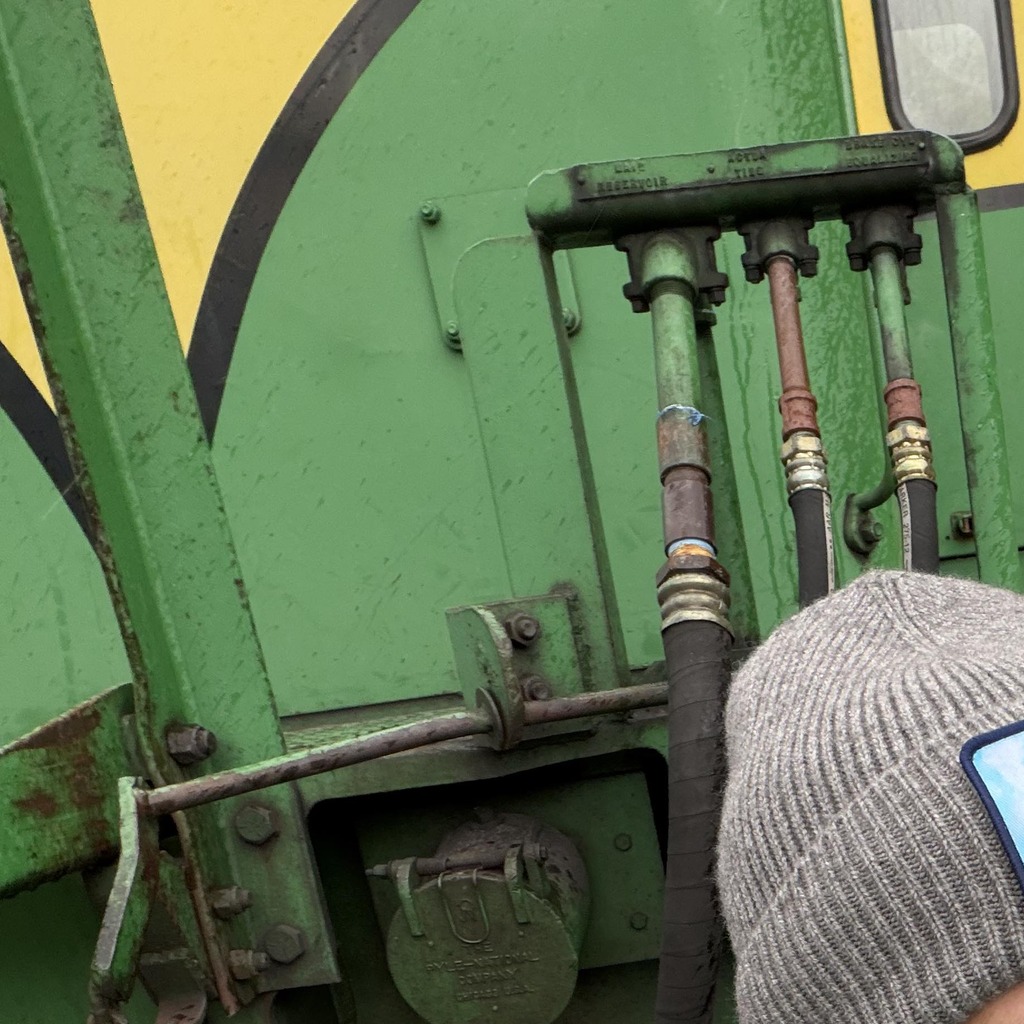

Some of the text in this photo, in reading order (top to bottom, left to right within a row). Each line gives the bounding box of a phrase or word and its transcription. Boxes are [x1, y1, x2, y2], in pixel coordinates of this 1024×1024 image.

[847, 151, 918, 168] EQUALIZING
[597, 176, 668, 193] RESERVOIR
[898, 485, 909, 518] ARKER
[426, 952, 540, 973] PYLE-NATIONAL
[458, 967, 520, 985] COMPANY
